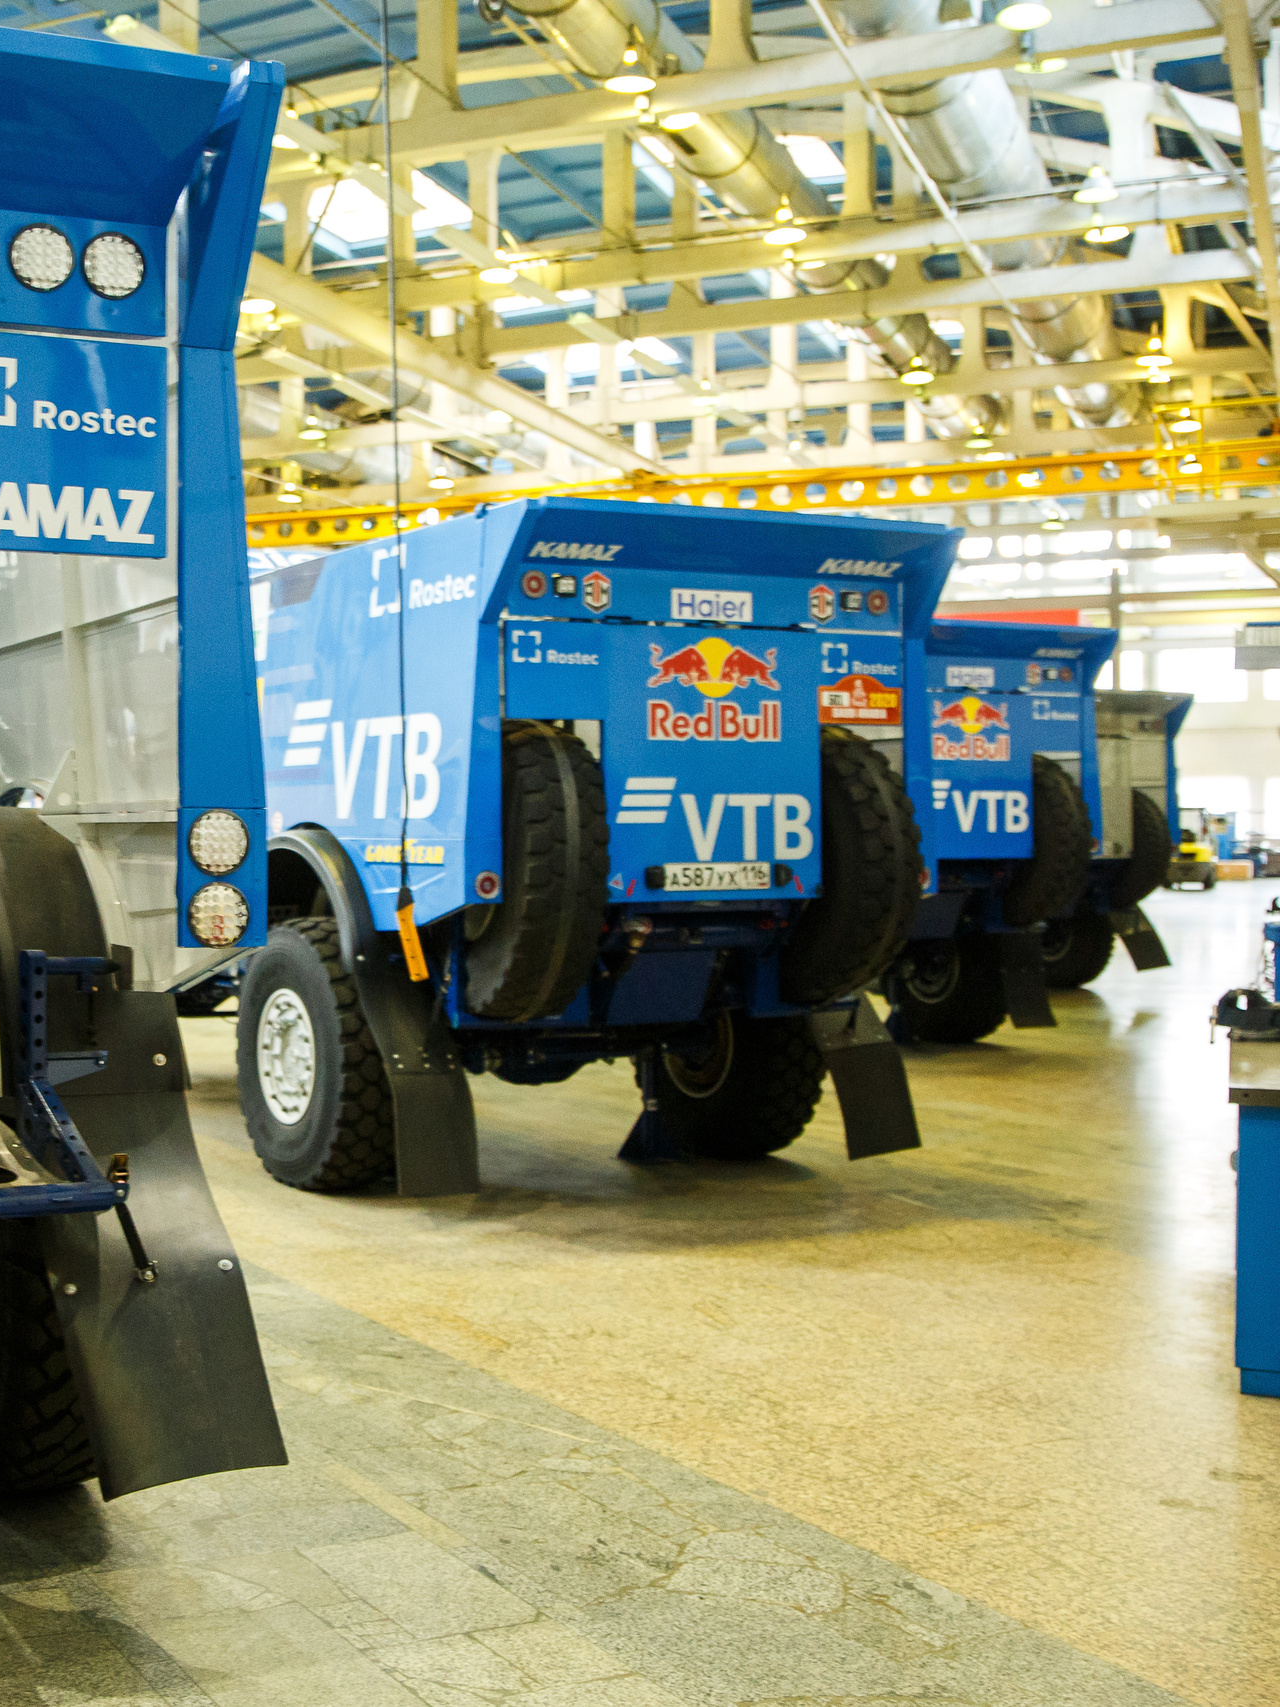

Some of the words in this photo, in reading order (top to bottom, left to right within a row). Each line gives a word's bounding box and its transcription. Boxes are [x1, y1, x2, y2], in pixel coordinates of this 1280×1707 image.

[33, 400, 157, 438] Rostec
[528, 541, 623, 561] KAMAZ
[408, 574, 477, 609] Rostec
[676, 593, 746, 619] Haier
[546, 649, 599, 665] Rostec
[647, 700, 717, 740] Red
[720, 702, 782, 742] Bull
[932, 734, 969, 760] Red
[970, 735, 1010, 761] Bull
[330, 712, 442, 820] VTB
[680, 794, 814, 861] VTB
[951, 790, 1030, 833] VTB
